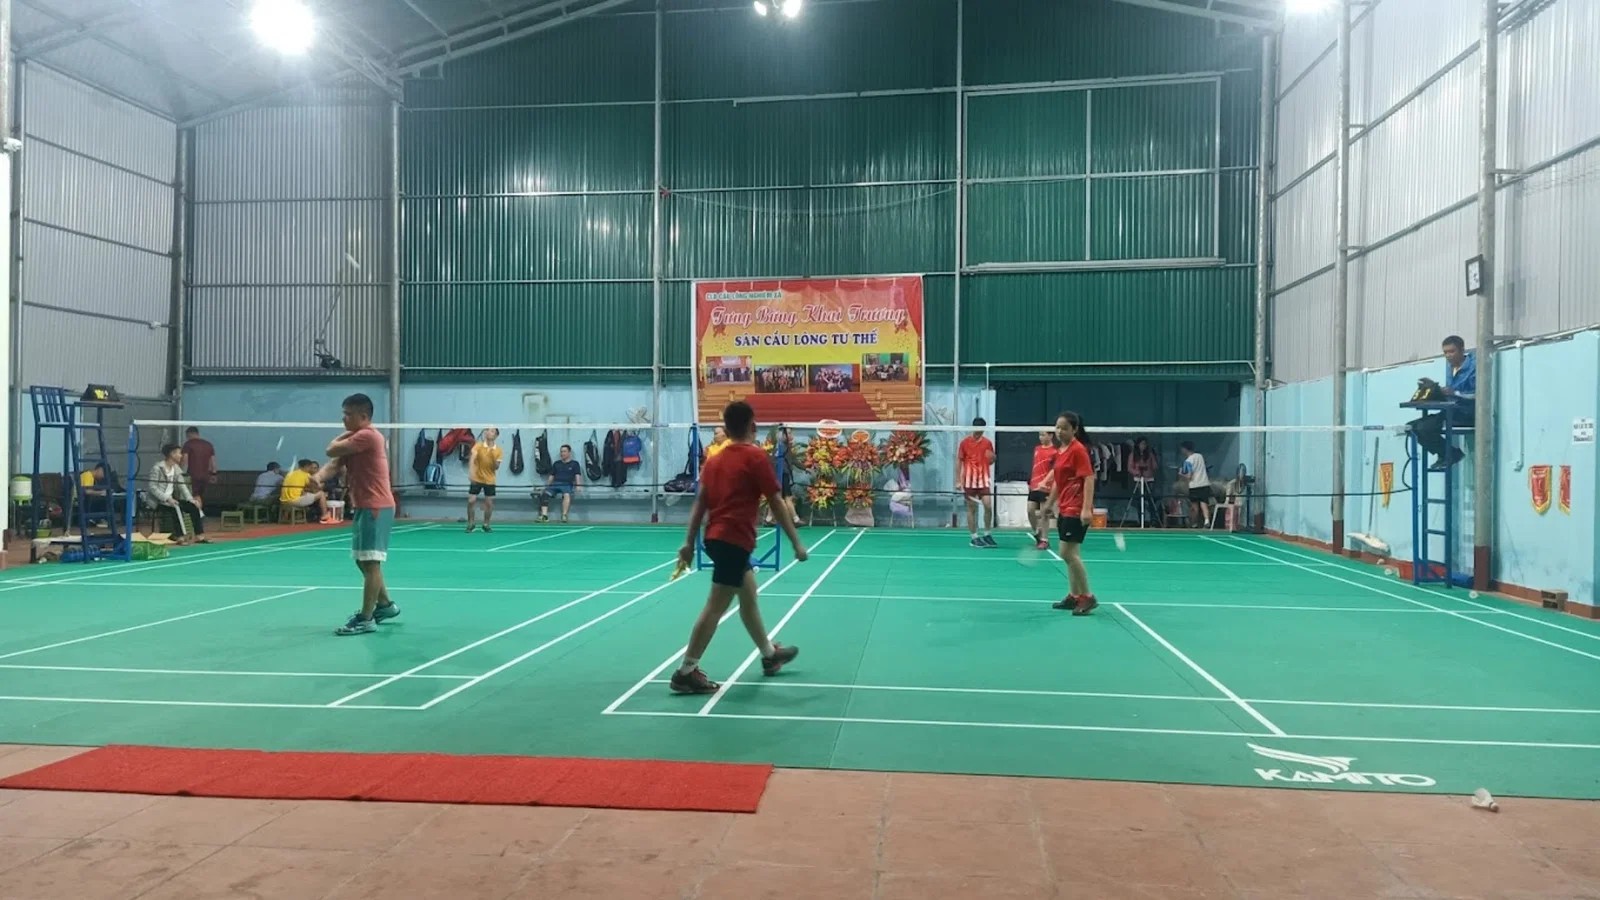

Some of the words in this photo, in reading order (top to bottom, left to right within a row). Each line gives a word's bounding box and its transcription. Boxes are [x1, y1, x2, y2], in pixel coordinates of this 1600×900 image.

[711, 306, 752, 328] Tưng
[801, 304, 842, 323] Khai
[848, 303, 906, 324] Trương
[735, 332, 760, 346] SÂN
[794, 331, 828, 345] LÔNG
[853, 328, 877, 344] THẾ
[1254, 768, 1437, 787] KAMITO
